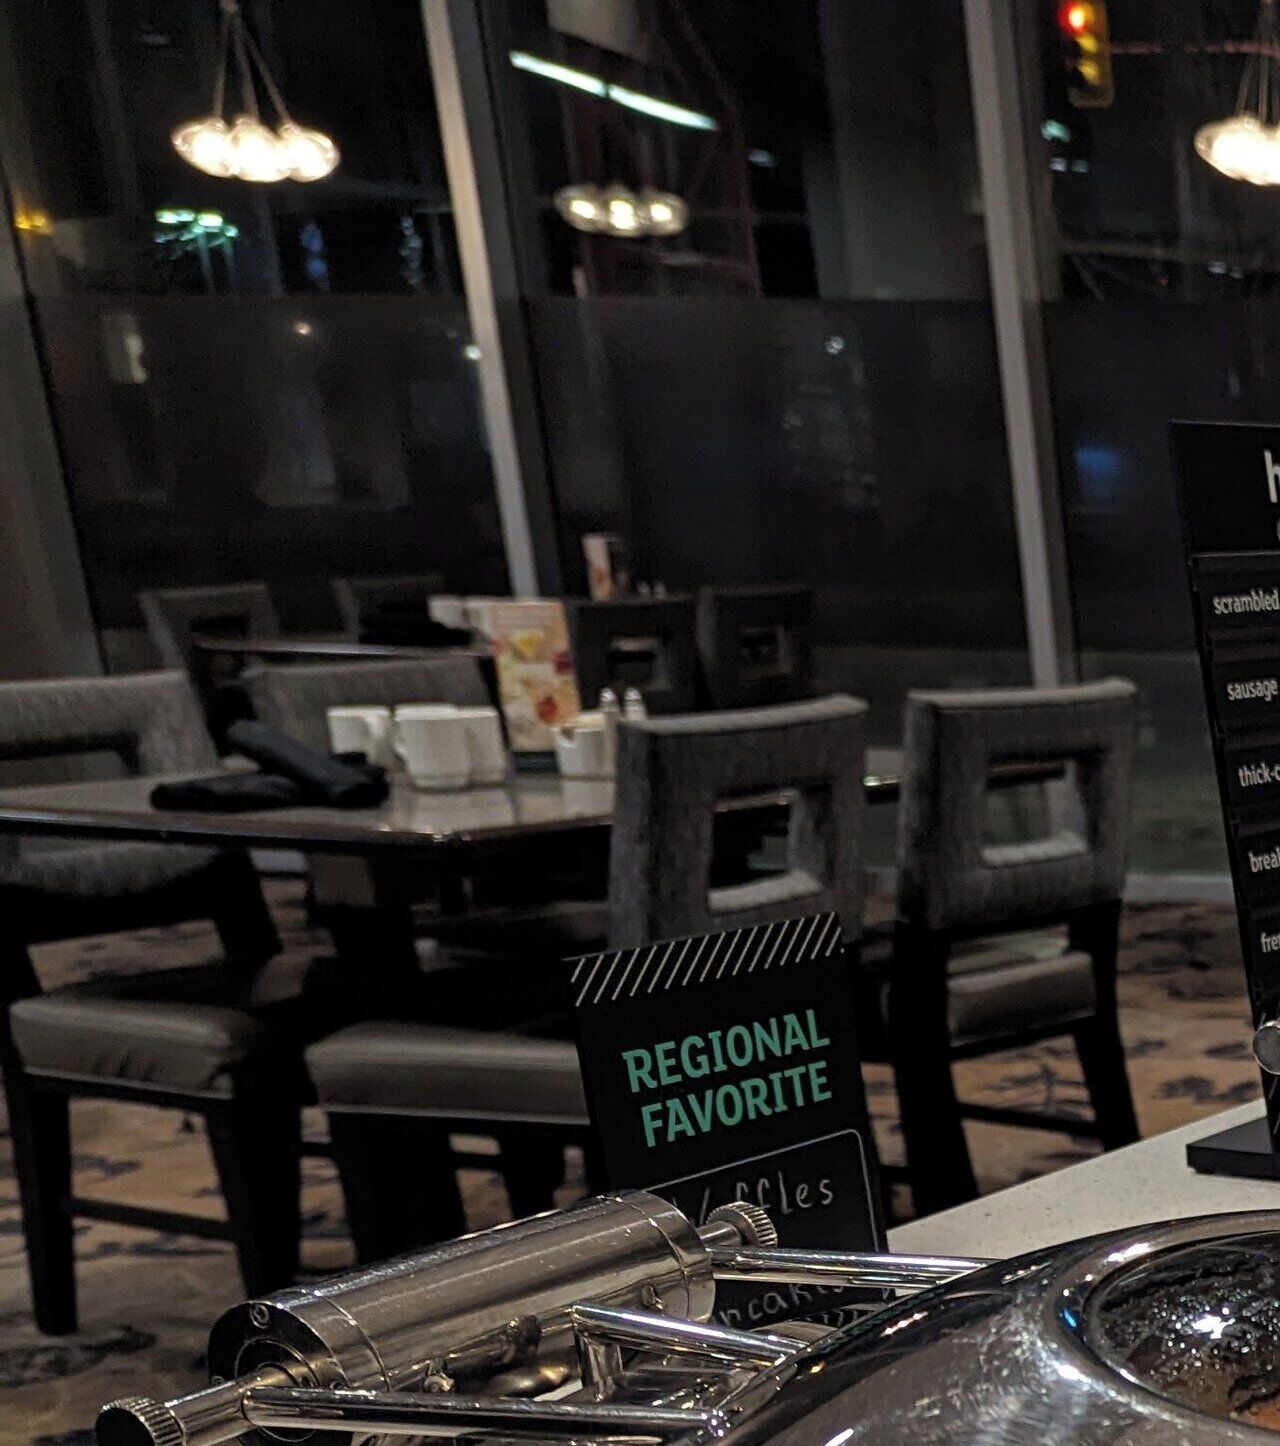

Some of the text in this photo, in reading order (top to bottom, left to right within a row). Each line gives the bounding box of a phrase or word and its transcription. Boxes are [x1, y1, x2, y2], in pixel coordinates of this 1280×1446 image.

[1212, 587, 1280, 614] scrambled
[1226, 678, 1278, 701] sausage
[621, 1008, 831, 1093] REGIONAL
[641, 1060, 832, 1148] FAVORITE
